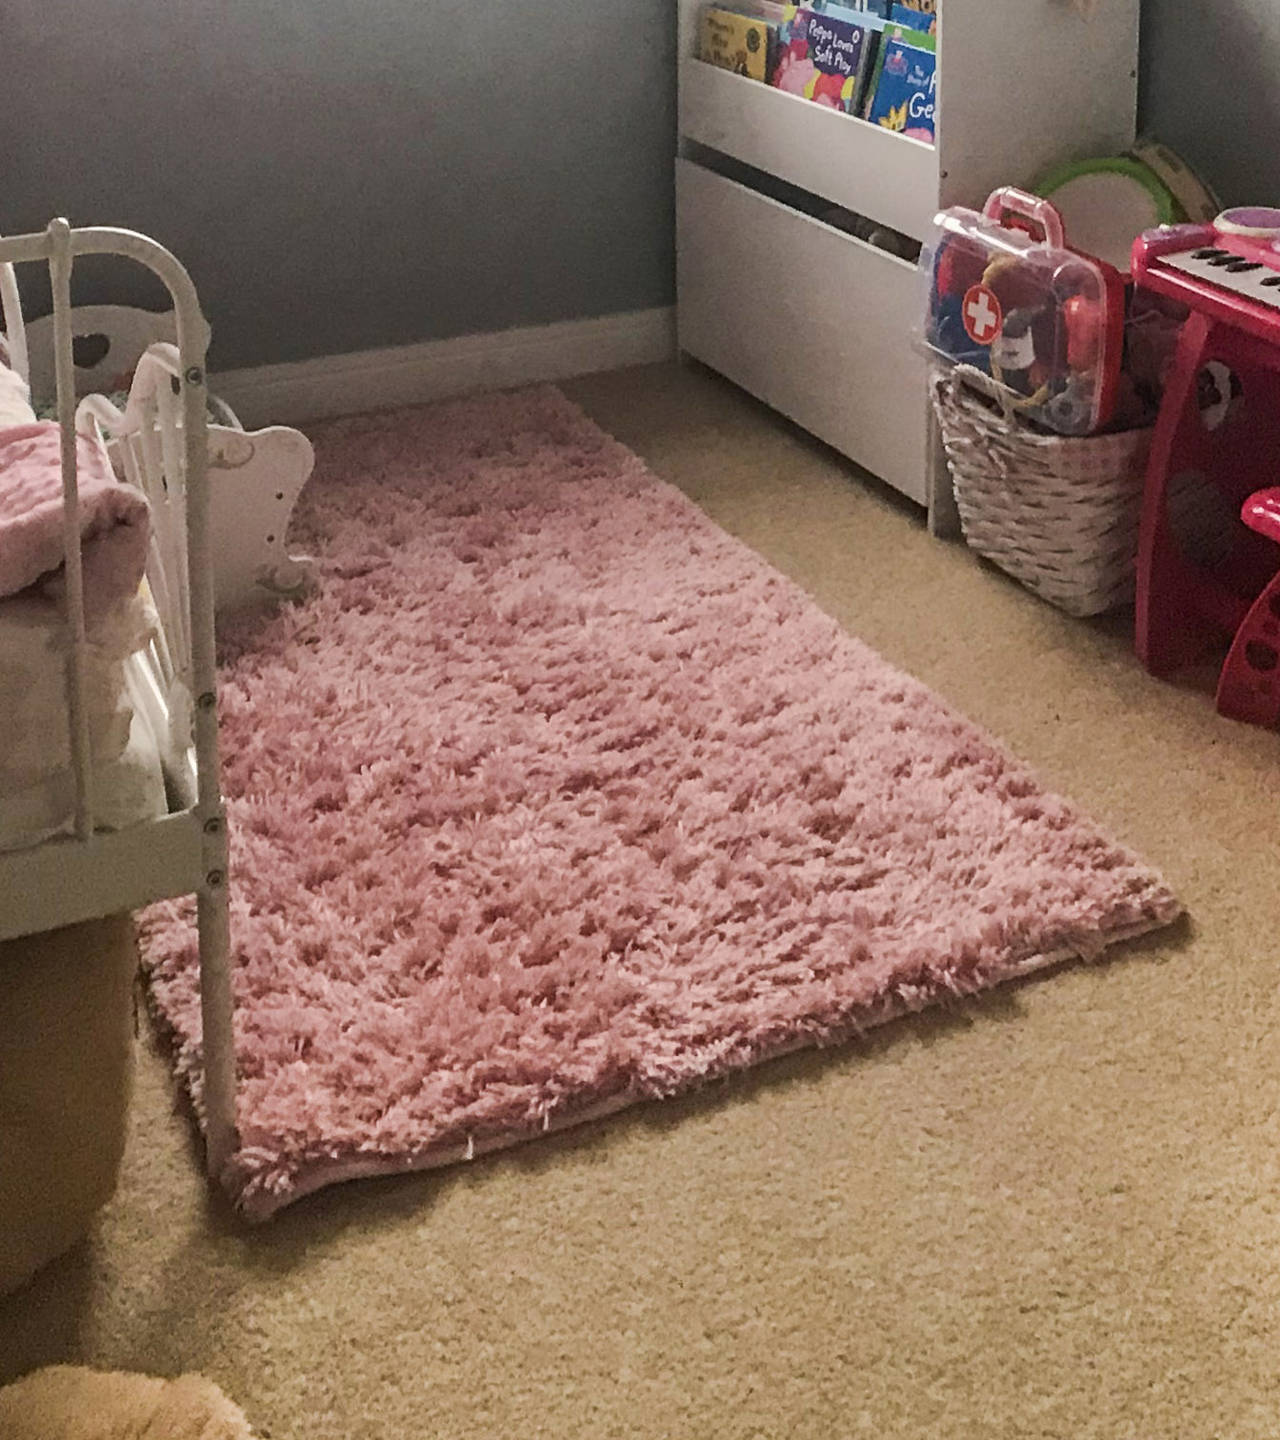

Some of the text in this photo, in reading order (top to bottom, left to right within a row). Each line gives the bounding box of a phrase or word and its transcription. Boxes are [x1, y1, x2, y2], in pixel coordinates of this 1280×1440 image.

[808, 18, 833, 45] Peppa
[814, 44, 852, 76] Soft Play
